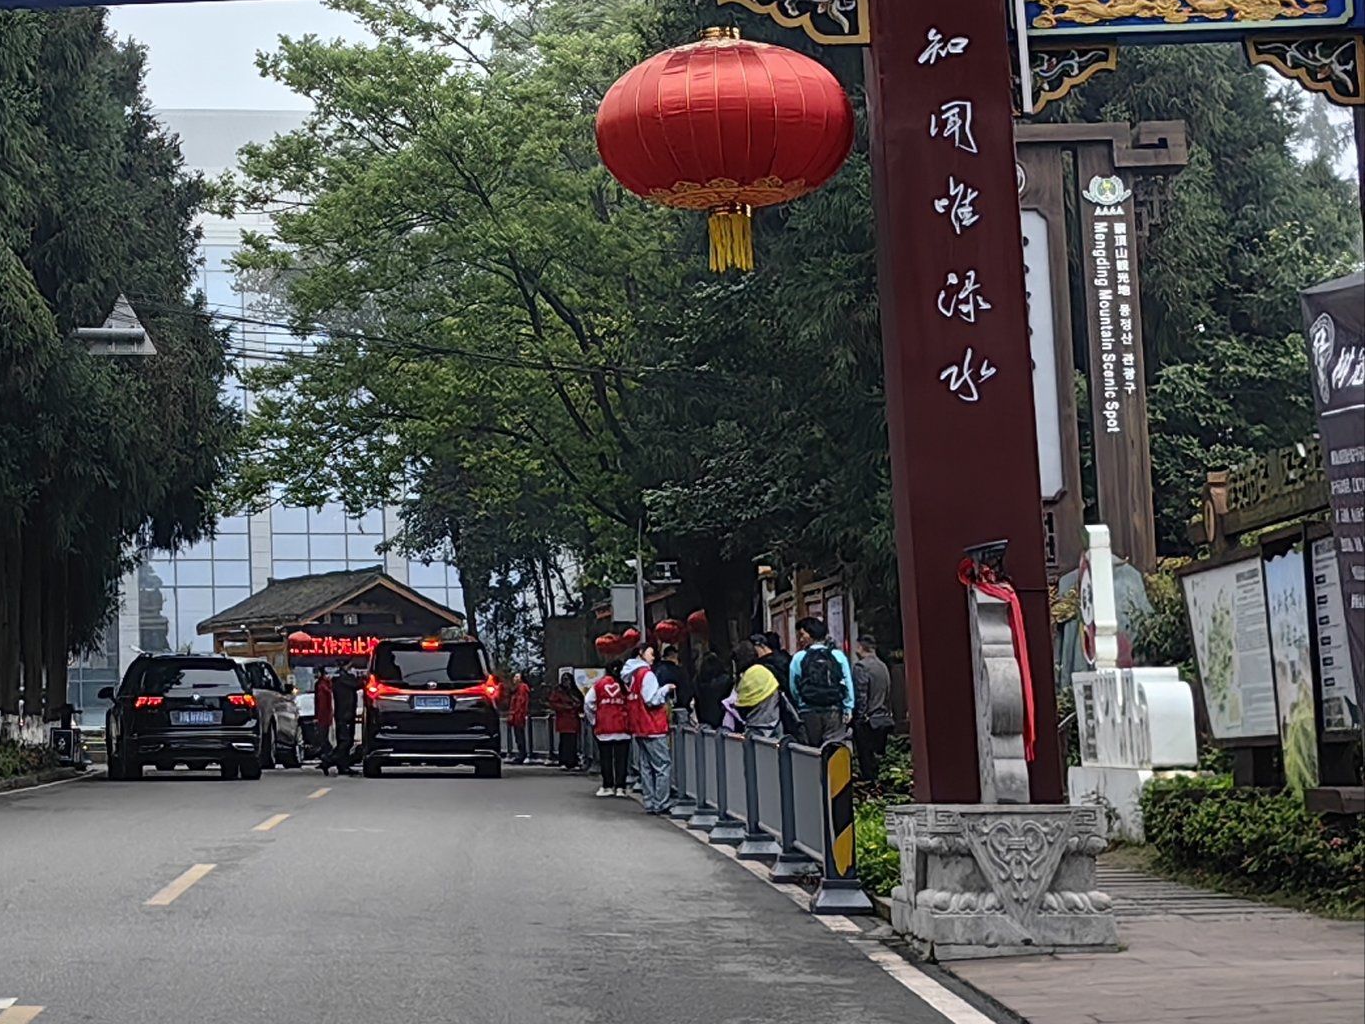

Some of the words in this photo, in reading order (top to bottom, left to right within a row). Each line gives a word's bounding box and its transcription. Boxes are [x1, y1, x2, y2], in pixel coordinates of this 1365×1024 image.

[1092, 222, 1111, 287] Mengding
[1098, 289, 1116, 351] Mountain
[1102, 353, 1118, 399] Scenic
[1103, 401, 1120, 433] Spot
